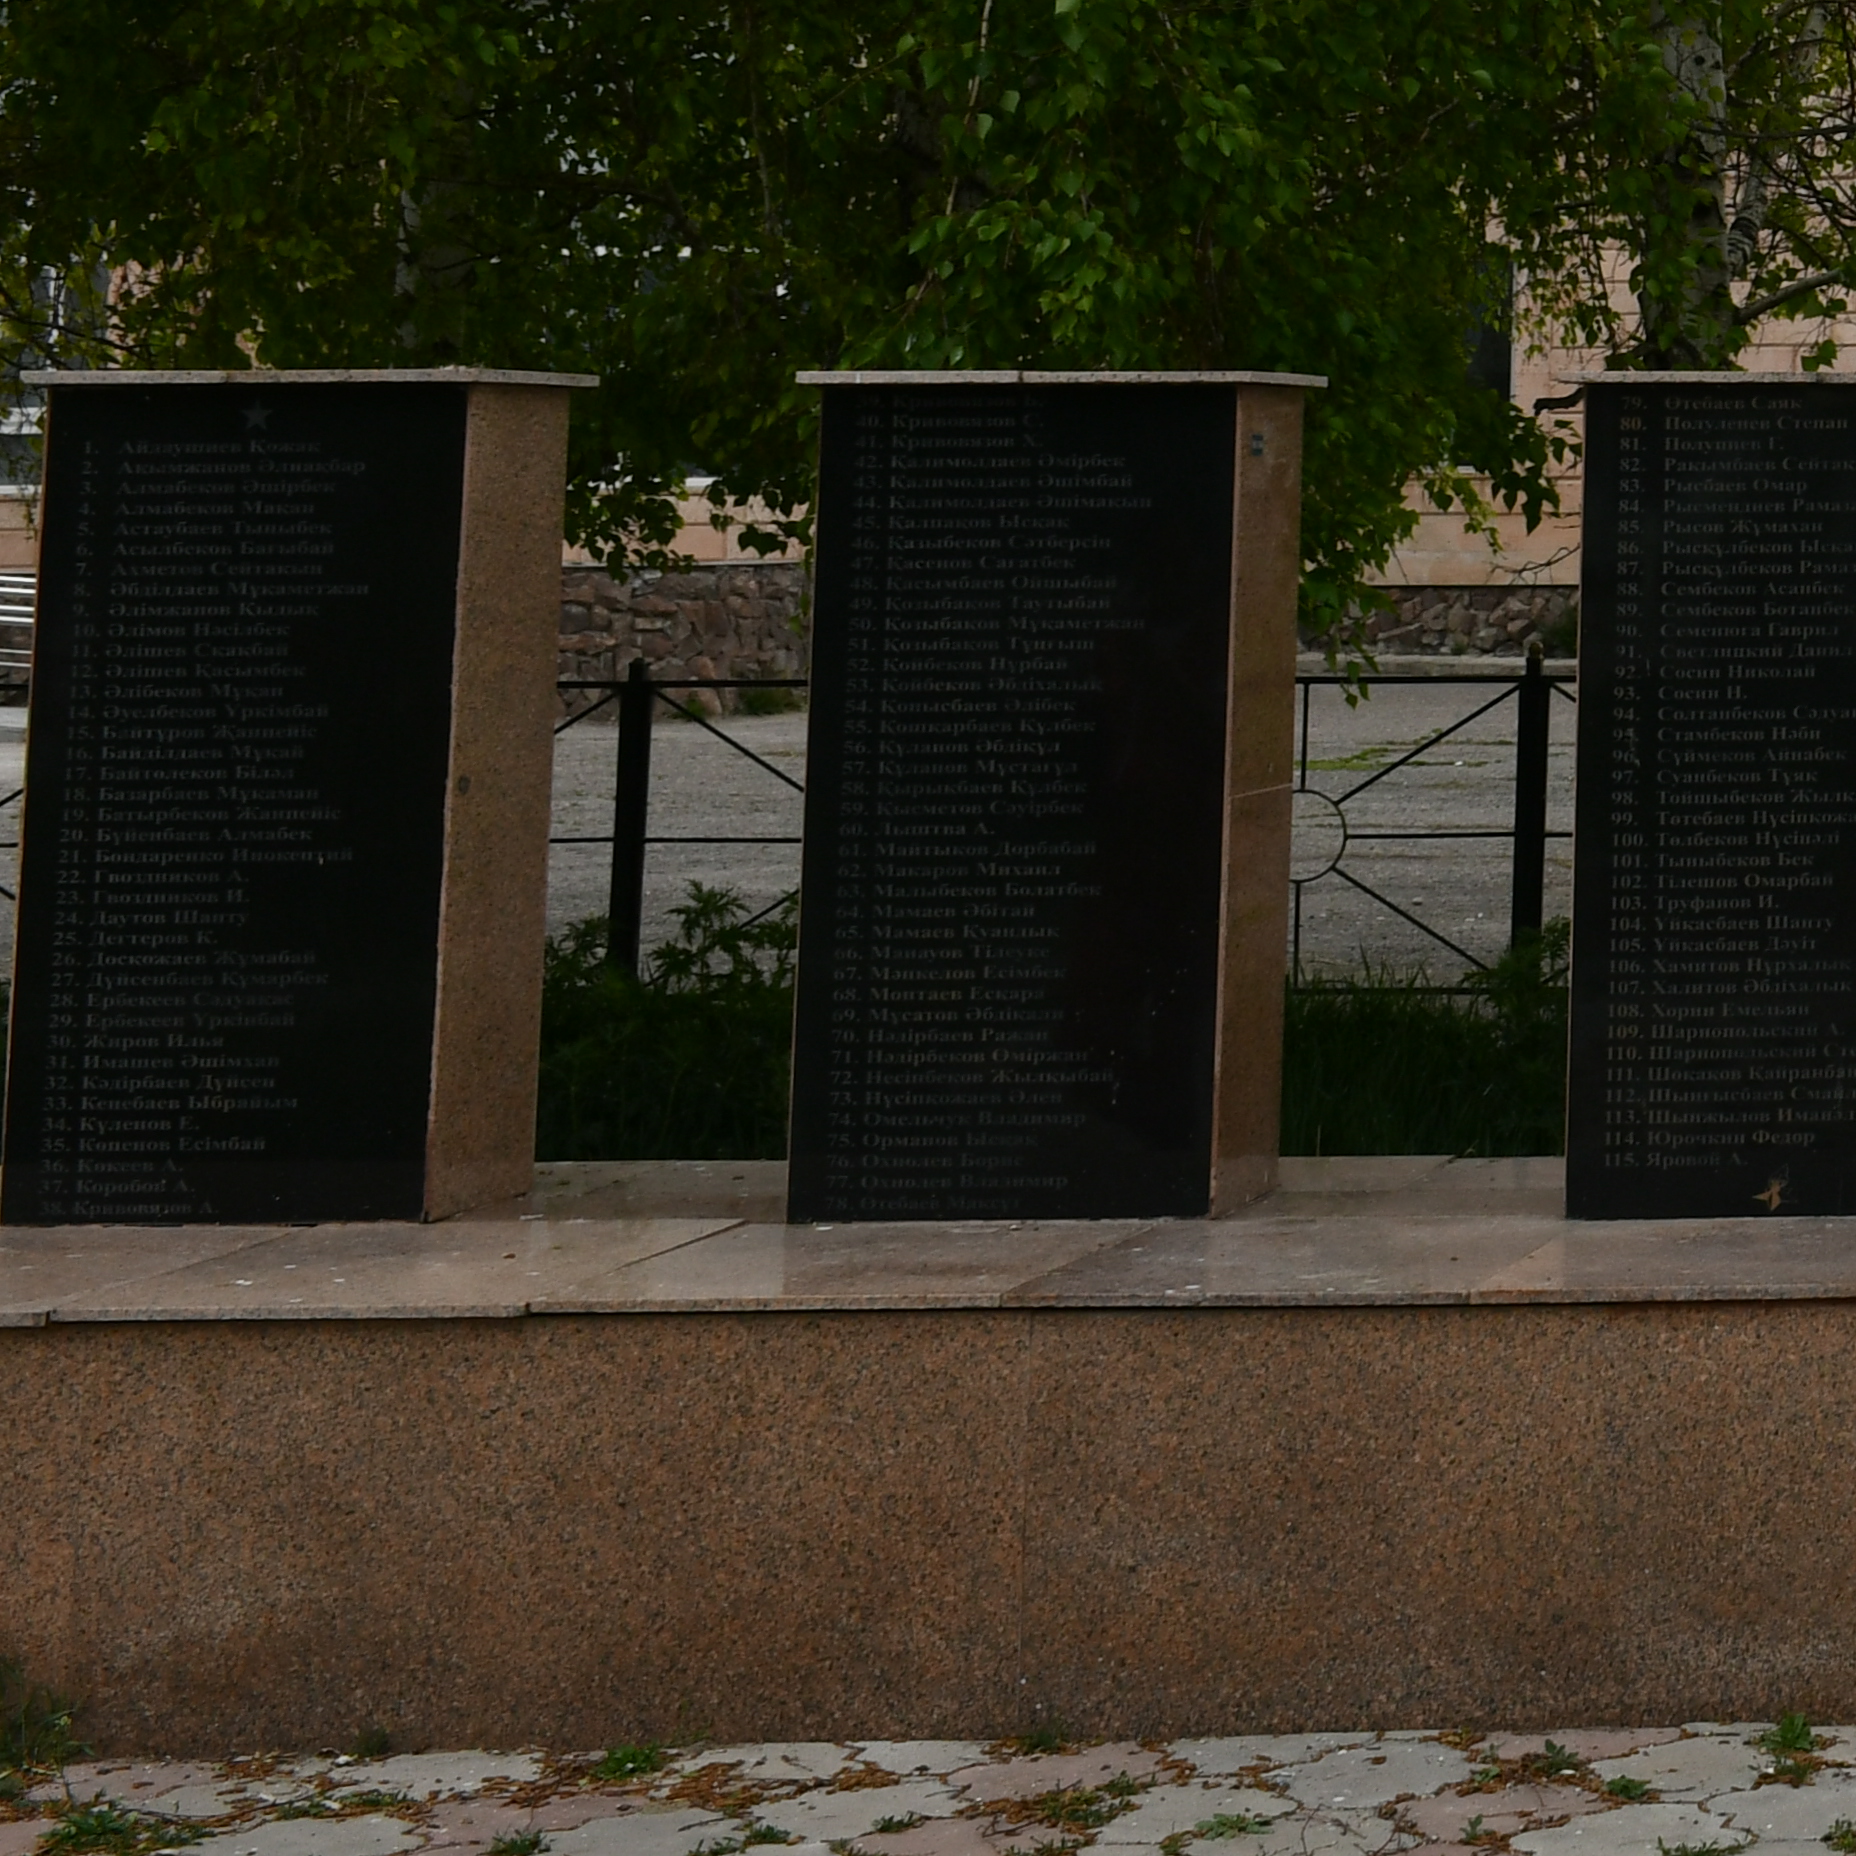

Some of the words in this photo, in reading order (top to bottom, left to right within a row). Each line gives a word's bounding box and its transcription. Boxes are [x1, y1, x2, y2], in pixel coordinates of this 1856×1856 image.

[80, 481, 97, 495] 3.
[1618, 479, 1646, 493] 83.
[851, 535, 879, 549] 46.
[1615, 665, 1642, 679] 92.
[1614, 686, 1642, 700] 93.
[844, 699, 873, 713] 54.
[839, 801, 868, 815] 59.
[60, 828, 87, 842] 20.
[838, 822, 868, 836] 60.
[838, 843, 866, 857] 61.
[57, 870, 86, 884] 22.
[837, 864, 866, 878] 62.
[1611, 875, 1648, 889] 102.
[1611, 896, 1647, 910] 103.
[47, 1034, 76, 1048] 30.
[45, 1056, 75, 1070] 31.
[44, 1076, 74, 1089] 32.
[43, 1096, 73, 1109] 33.
[1605, 1131, 1641, 1145] 114.
[1604, 1153, 1640, 1167] 115.
